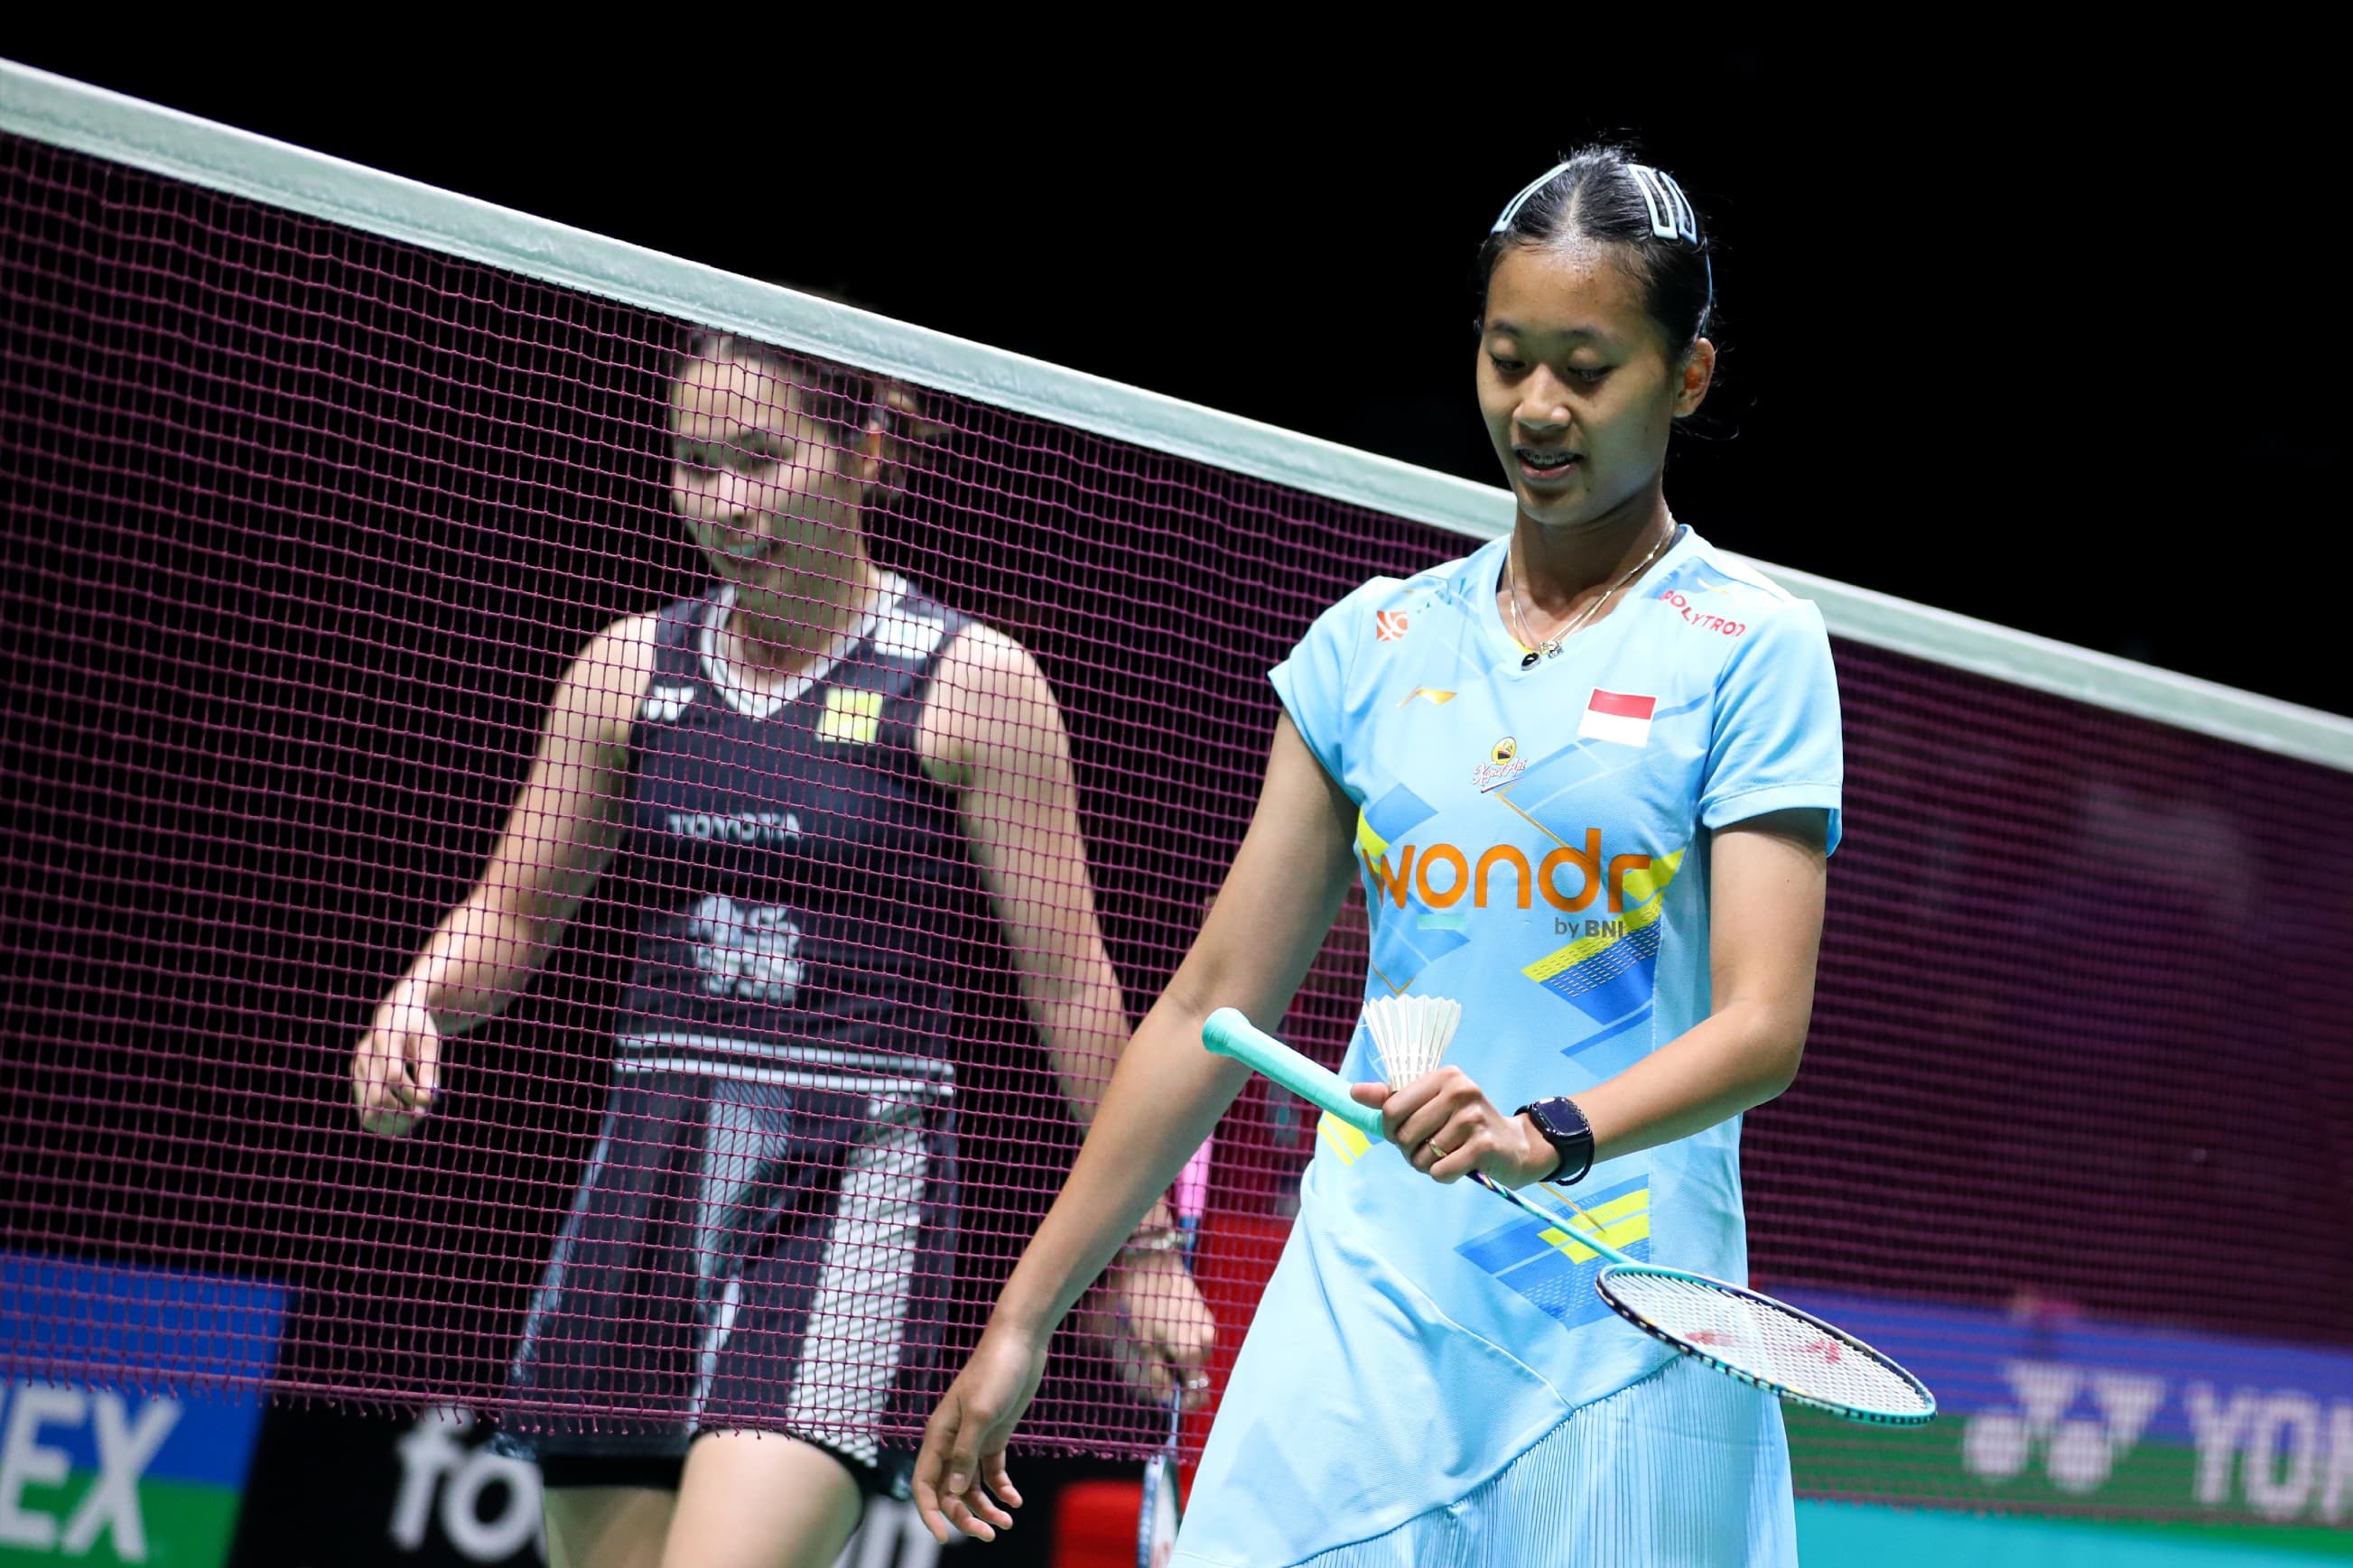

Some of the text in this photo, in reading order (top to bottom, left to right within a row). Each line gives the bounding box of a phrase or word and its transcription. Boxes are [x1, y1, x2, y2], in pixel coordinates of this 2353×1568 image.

[667, 812, 802, 842] TOYOTA
[1362, 827, 1651, 914] wondr
[1554, 916, 1625, 939] by BNI
[0, 1377, 184, 1565] EX
[392, 1402, 547, 1568] fo
